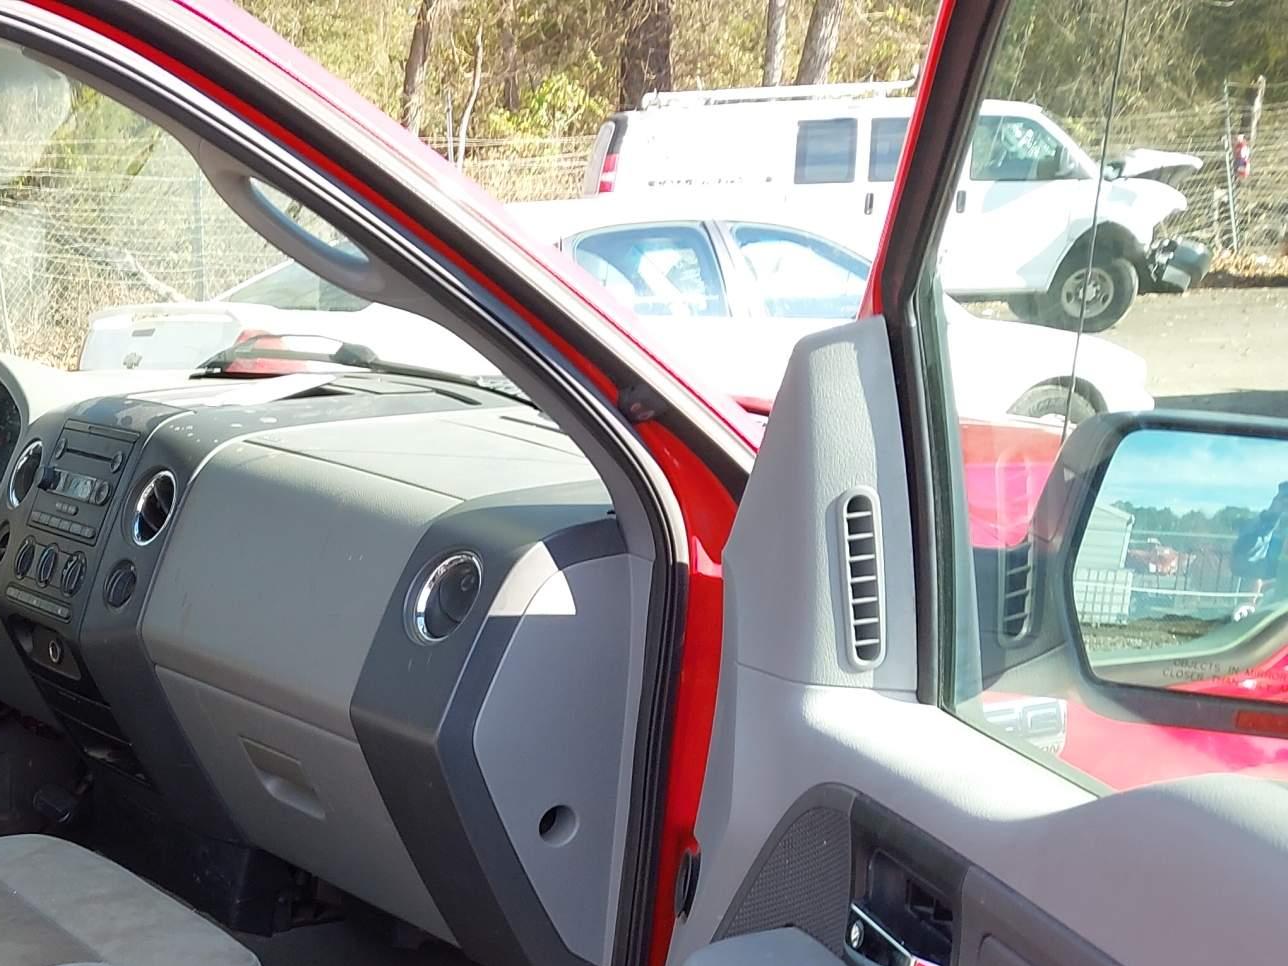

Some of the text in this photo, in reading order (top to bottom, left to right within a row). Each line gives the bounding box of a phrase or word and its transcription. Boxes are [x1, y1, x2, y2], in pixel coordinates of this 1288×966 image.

[1173, 658, 1221, 673] OBJECTS
[1228, 665, 1240, 674] IN
[1162, 667, 1204, 681] CLOSER
